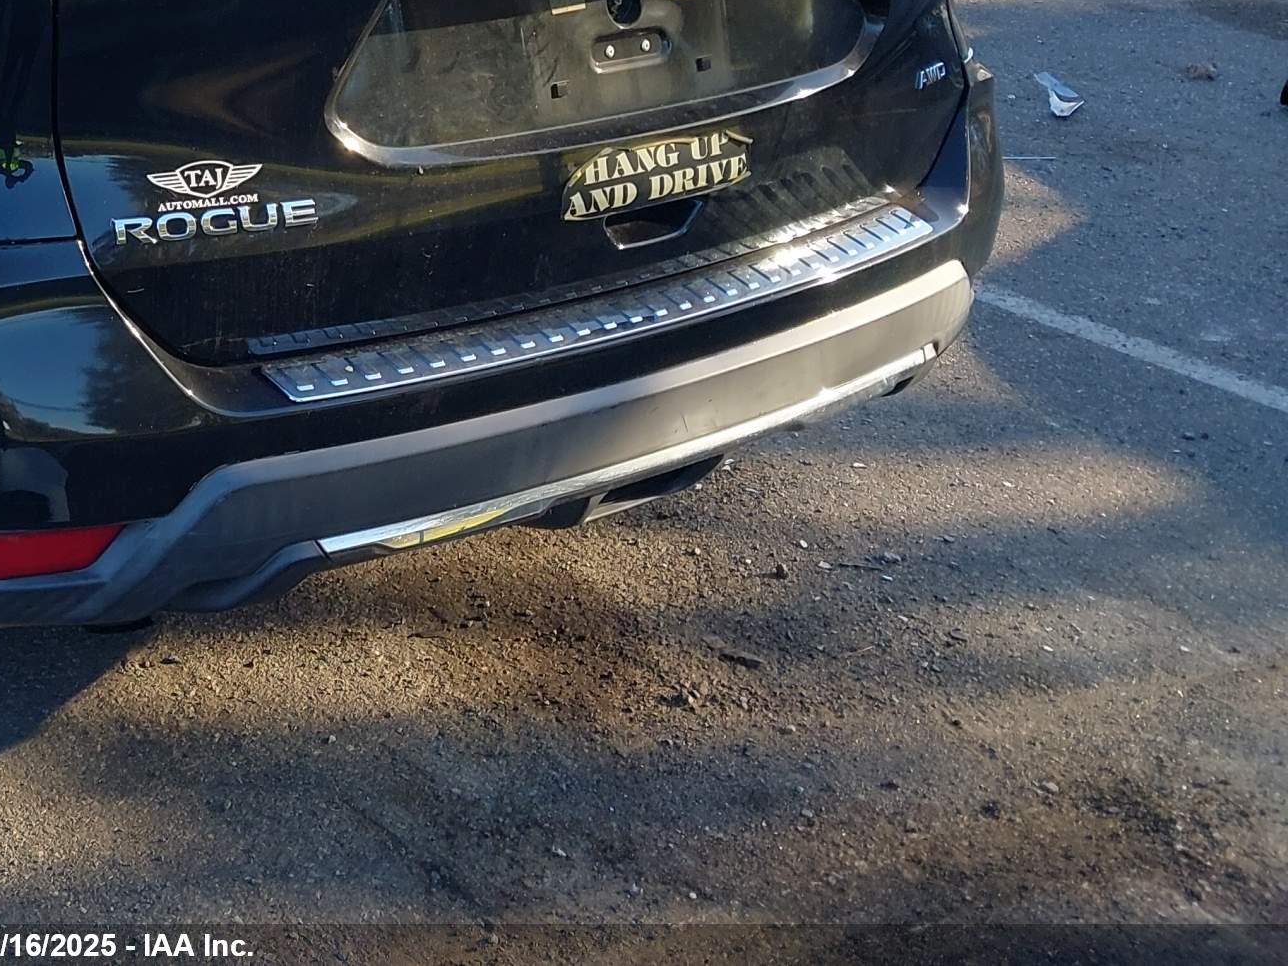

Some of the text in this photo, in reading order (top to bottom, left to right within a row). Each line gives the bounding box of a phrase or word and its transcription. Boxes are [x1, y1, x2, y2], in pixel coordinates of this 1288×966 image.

[914, 62, 946, 90] AWD
[184, 166, 225, 190] TAJ
[583, 133, 729, 186] HANG UP
[158, 193, 260, 212] AUTOMALL.COM
[568, 153, 748, 217] AND DRIVE
[111, 199, 319, 246] ROGUE
